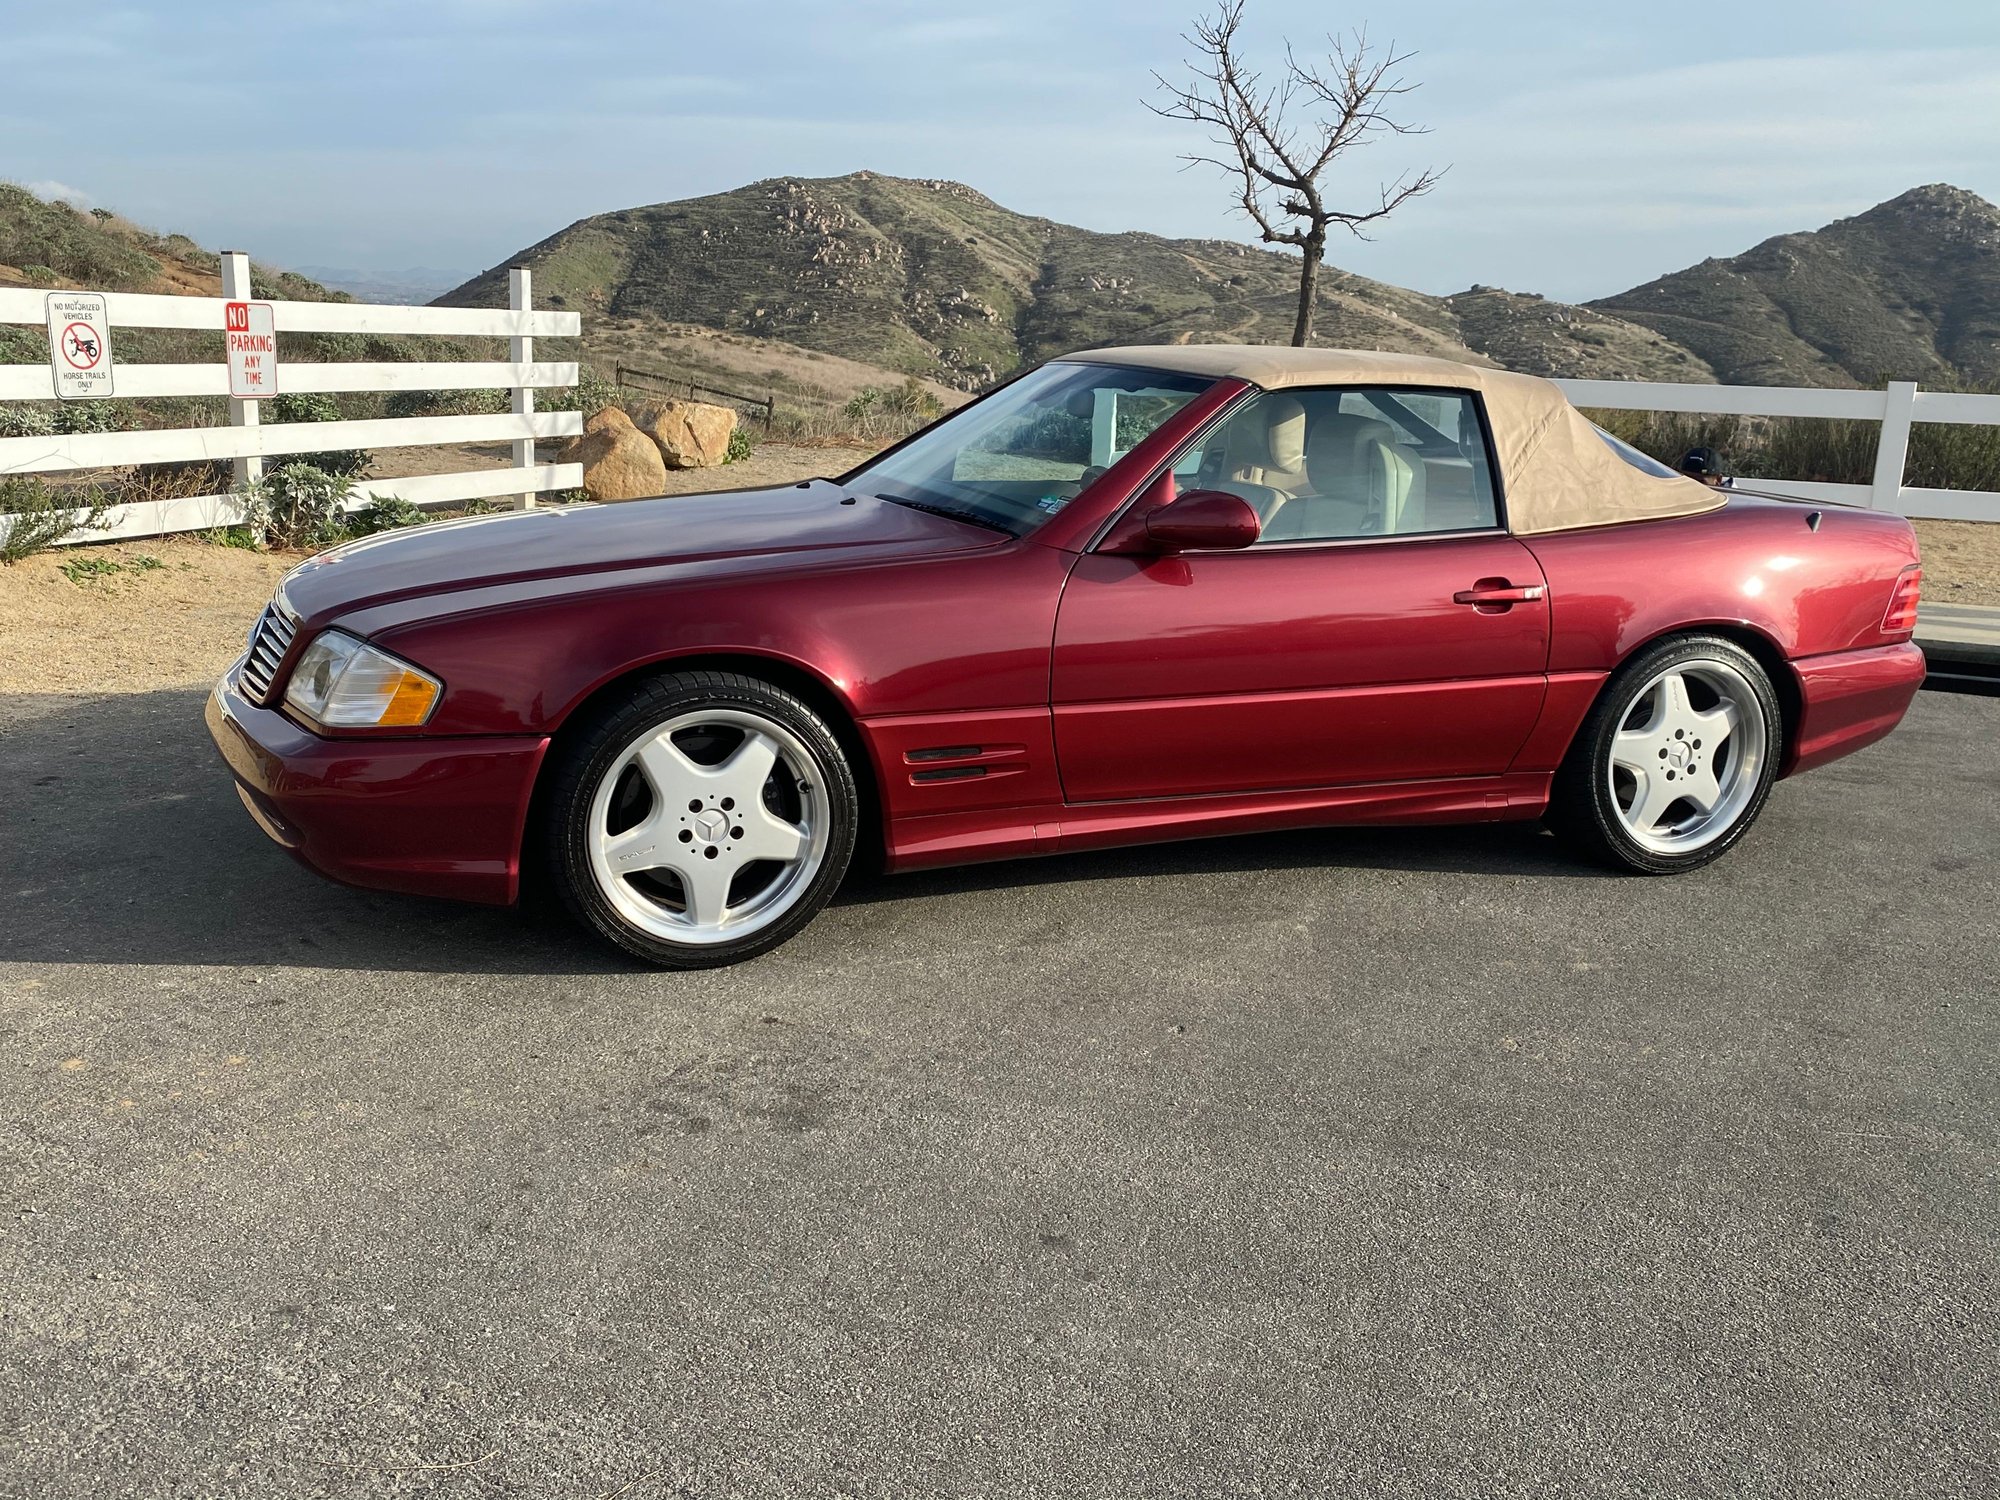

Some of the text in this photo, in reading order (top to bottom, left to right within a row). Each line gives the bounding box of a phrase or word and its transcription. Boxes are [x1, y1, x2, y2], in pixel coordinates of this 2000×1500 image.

[54, 302, 101, 311] NO MOTORIZED
[63, 312, 93, 321] VEHICLES
[228, 306, 246, 328] NO
[230, 334, 273, 352] PARKING
[244, 355, 261, 368] ANY
[63, 371, 106, 380] HORSE TRAILS
[245, 372, 262, 385] TIME
[77, 381, 93, 389] ONLY
